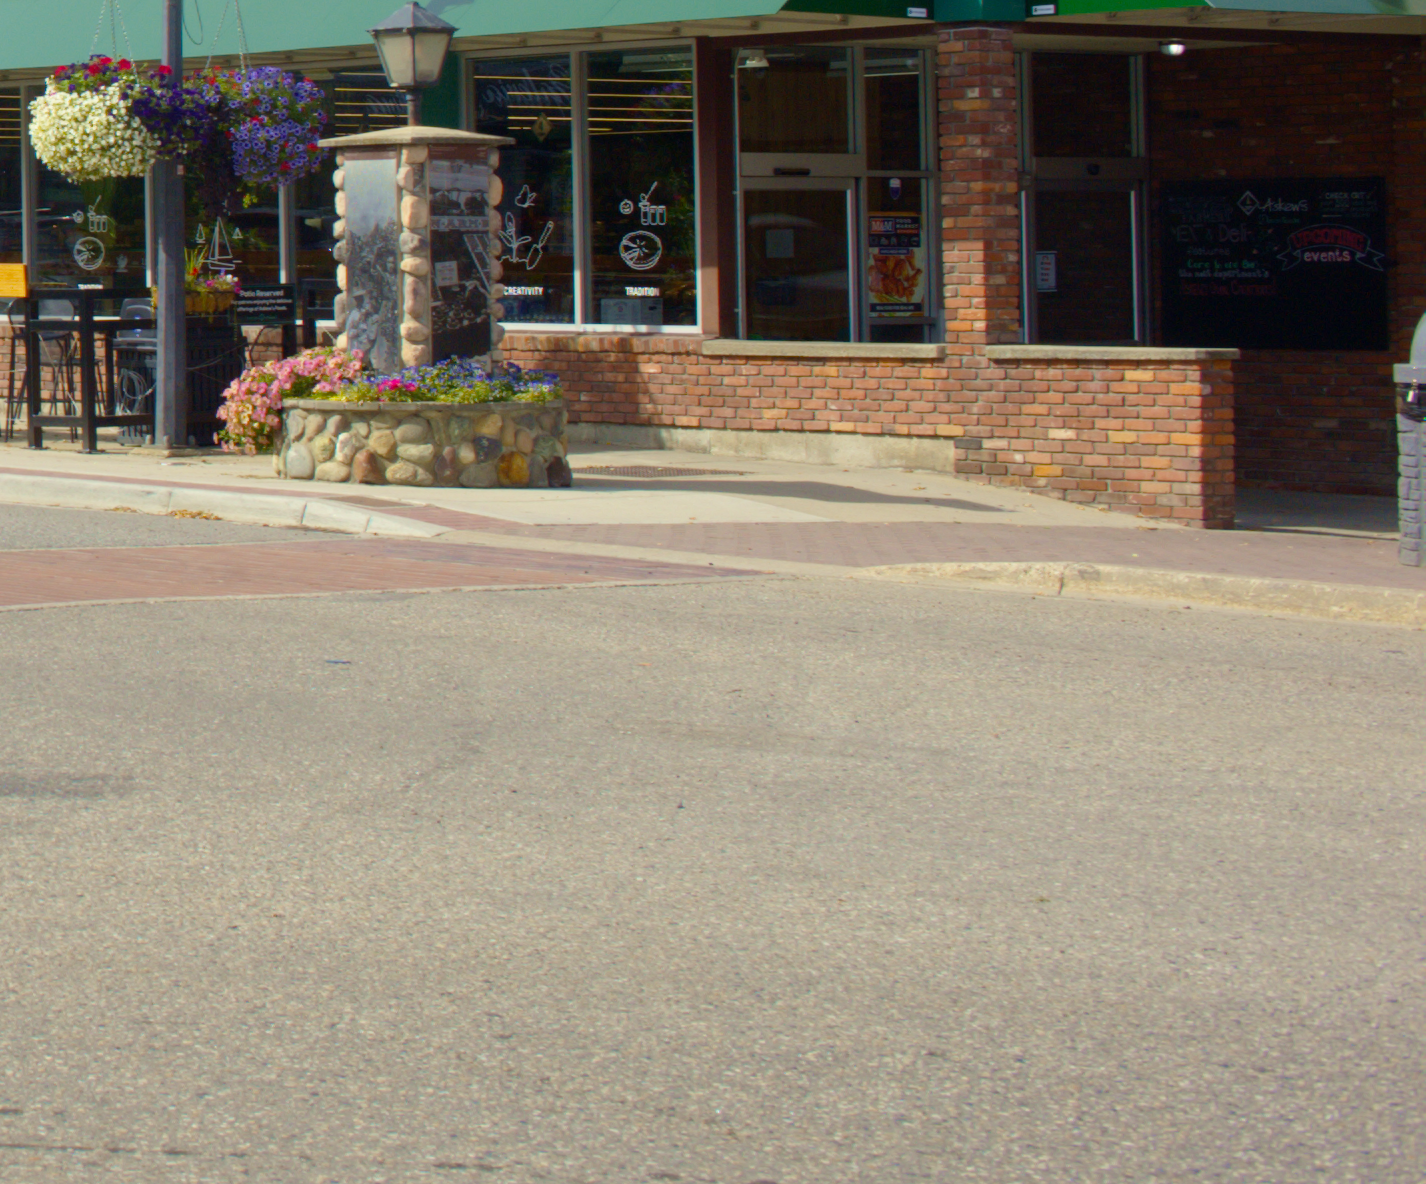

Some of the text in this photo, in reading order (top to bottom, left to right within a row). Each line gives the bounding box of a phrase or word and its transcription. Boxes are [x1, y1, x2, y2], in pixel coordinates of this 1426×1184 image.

[870, 219, 894, 232] M&M
[1292, 227, 1367, 253] UPCOMING
[1303, 249, 1352, 262] events
[503, 286, 544, 296] CREATIVITY
[625, 286, 660, 296] TRADITION
